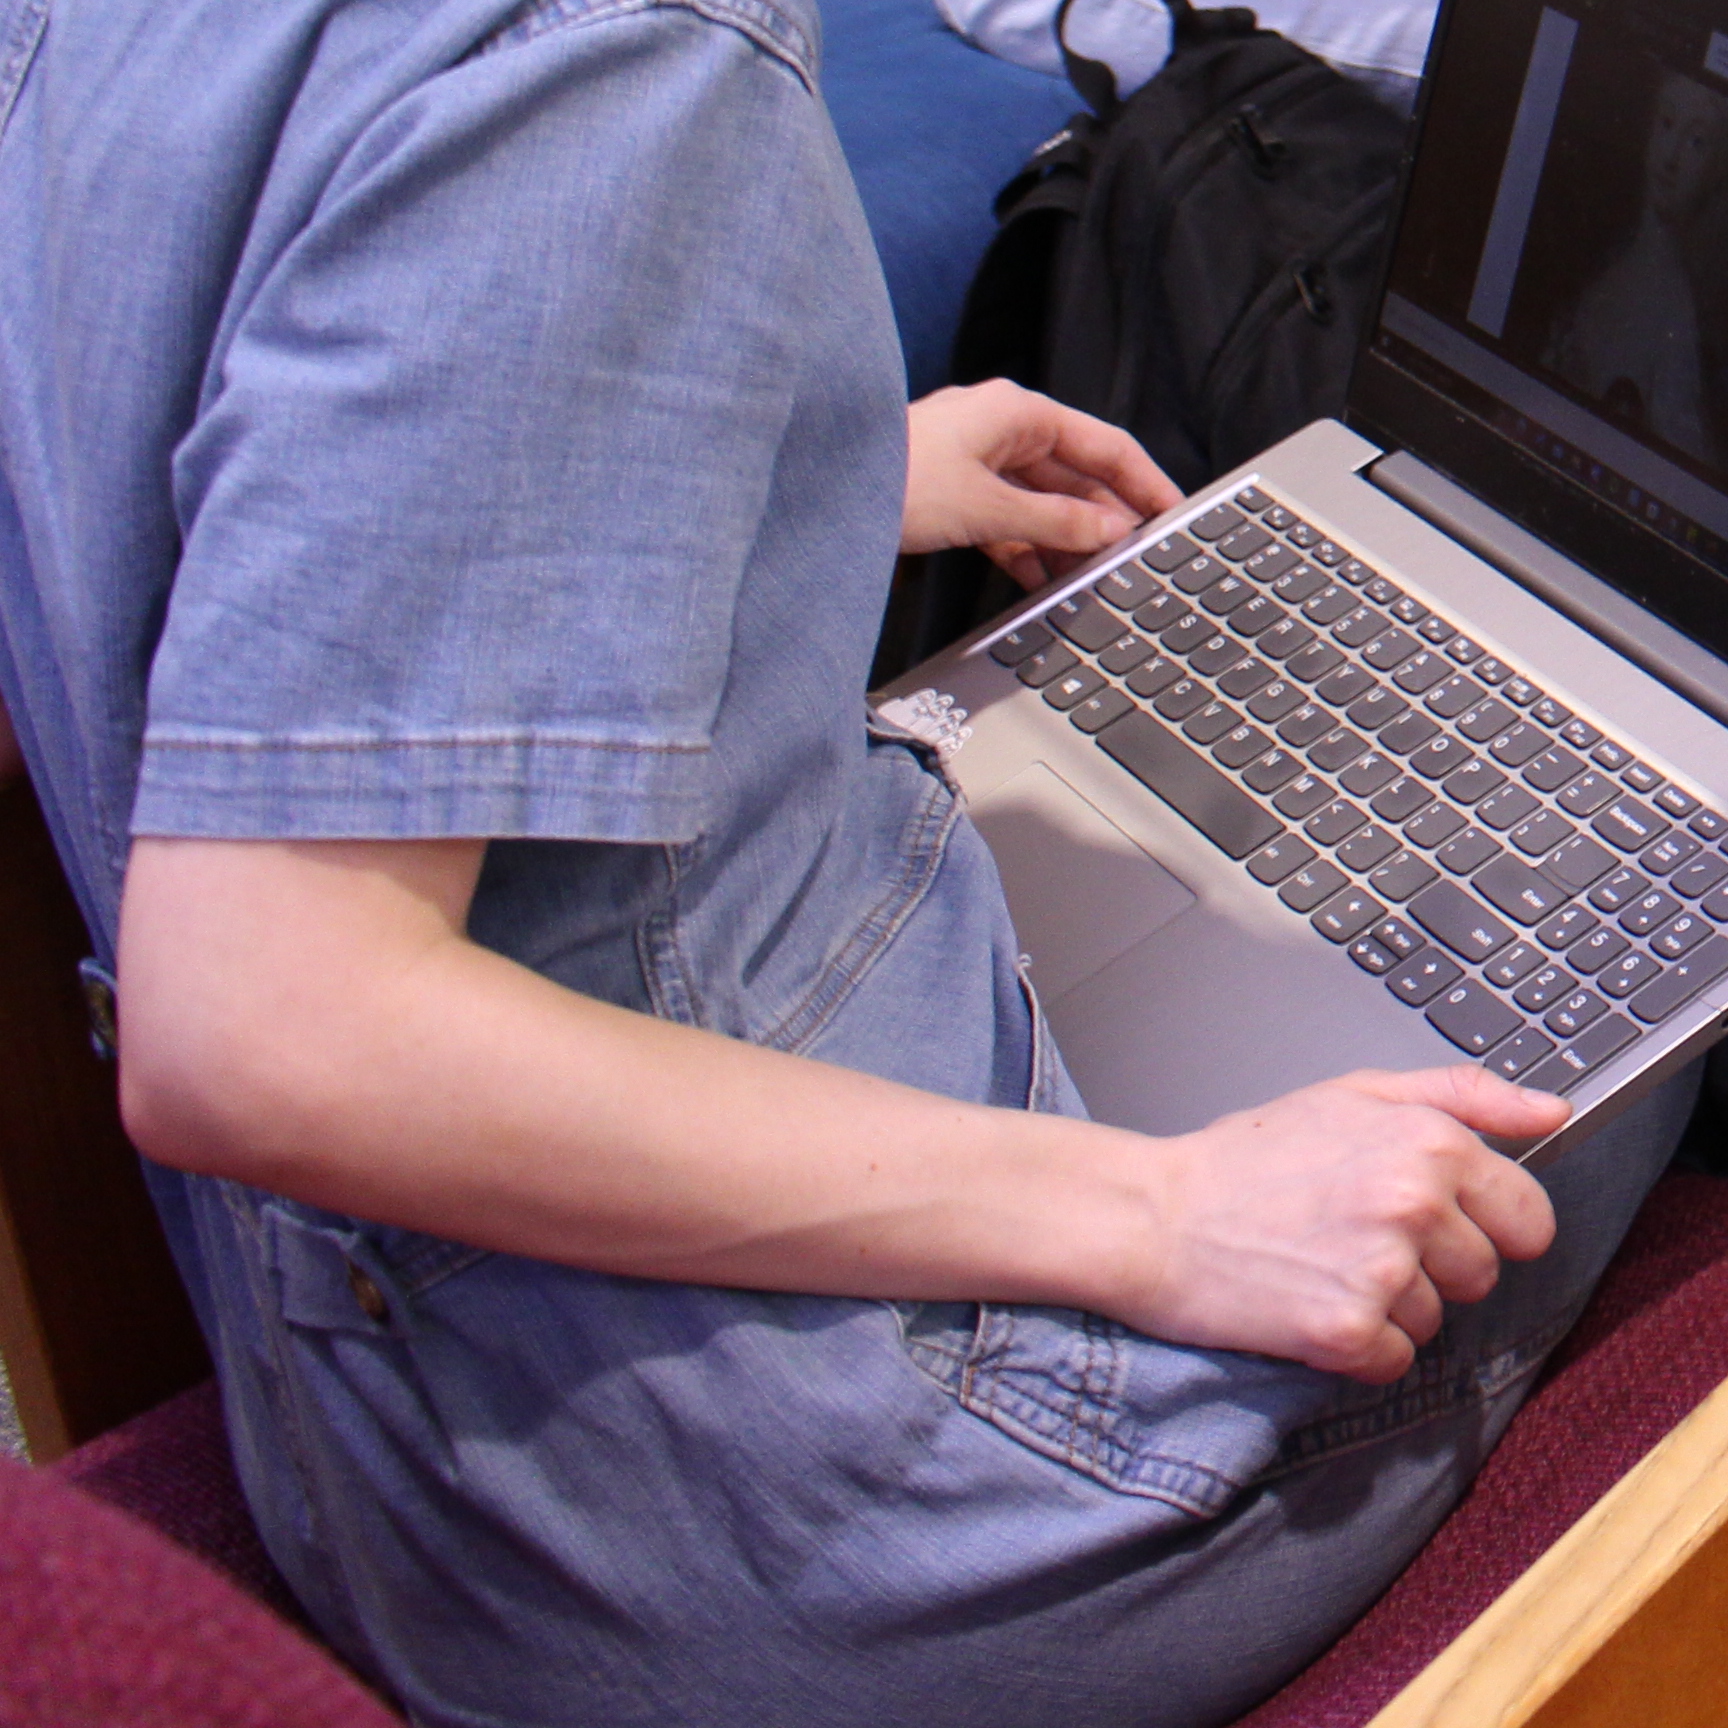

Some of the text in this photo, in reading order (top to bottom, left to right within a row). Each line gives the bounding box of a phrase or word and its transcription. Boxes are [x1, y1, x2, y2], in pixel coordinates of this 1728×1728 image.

[1223, 536, 1235, 547] 1
[1191, 557, 1209, 572] Q
[1247, 555, 1264, 568] 2
[1219, 576, 1240, 592] W
[1276, 575, 1292, 588] 3
[1151, 595, 1169, 608] A
[1247, 597, 1266, 611] E
[1308, 598, 1322, 609] 4
[1179, 615, 1197, 629] S
[1275, 619, 1294, 634] R
[1336, 619, 1352, 632] 5
[1116, 635, 1136, 650] Z
[1207, 635, 1225, 650] D
[1307, 640, 1325, 655] T
[1366, 642, 1382, 654] 6
[1144, 657, 1163, 672] X
[1237, 659, 1255, 671] F
[1337, 664, 1355, 678] Y
[1397, 664, 1414, 676] 7
[1174, 681, 1192, 695] C
[1267, 681, 1285, 697] G
[1367, 686, 1385, 703] U
[1429, 689, 1445, 701] 8
[1204, 700, 1222, 717] V
[1297, 705, 1316, 721] H
[1461, 712, 1477, 725] 9
[1231, 725, 1250, 741] B
[1327, 730, 1345, 743] J
[1261, 751, 1282, 767] N
[1357, 753, 1378, 770] K
[1462, 761, 1481, 773] P
[1293, 776, 1314, 793] M
[1390, 779, 1406, 794] L
[1612, 870, 1631, 885] 7
[1643, 895, 1661, 909] 8
[1562, 910, 1578, 923] 4
[1674, 918, 1692, 932] 9
[1590, 932, 1609, 947] 5
[1510, 947, 1525, 961] 1
[1622, 956, 1640, 971] 6
[1537, 970, 1556, 986] 2
[1569, 995, 1587, 1009] 3
